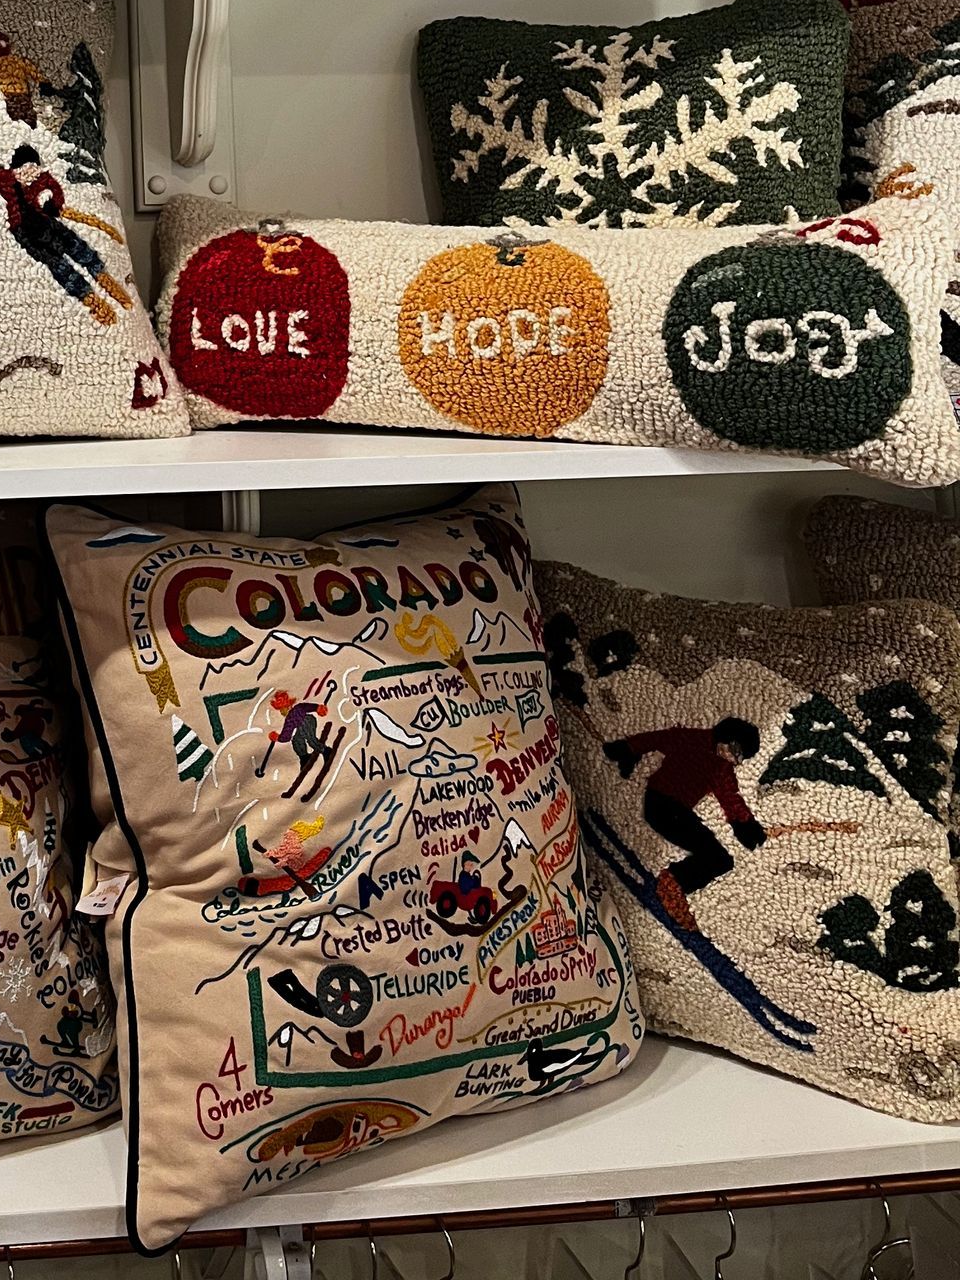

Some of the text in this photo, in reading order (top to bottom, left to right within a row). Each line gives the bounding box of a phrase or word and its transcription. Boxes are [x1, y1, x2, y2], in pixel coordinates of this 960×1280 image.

[191, 308, 310, 357] LOVE
[417, 309, 577, 361] HOPE
[132, 537, 306, 666] CENTENNIAL STATE
[163, 560, 500, 659] COLORADO
[350, 676, 433, 707] Steamboat
[445, 695, 515, 728] BOULDER
[349, 747, 407, 781] VAIL
[420, 774, 494, 805] LAKEWOOD
[412, 797, 496, 840] Breckenridge
[421, 834, 468, 857] Salida
[357, 865, 422, 910] ASPEN
[6, 866, 50, 978] Rockies
[321, 914, 433, 960] Crested Butte
[419, 941, 464, 965] Ouray
[511, 985, 556, 1006] PUEBLO
[484, 1025, 524, 1046] Great
[524, 1011, 560, 1039] Sand
[218, 1037, 246, 1091] 4
[466, 1061, 513, 1080] LARK
[454, 1076, 528, 1098] BUNTING
[196, 1082, 274, 1140] Corners
